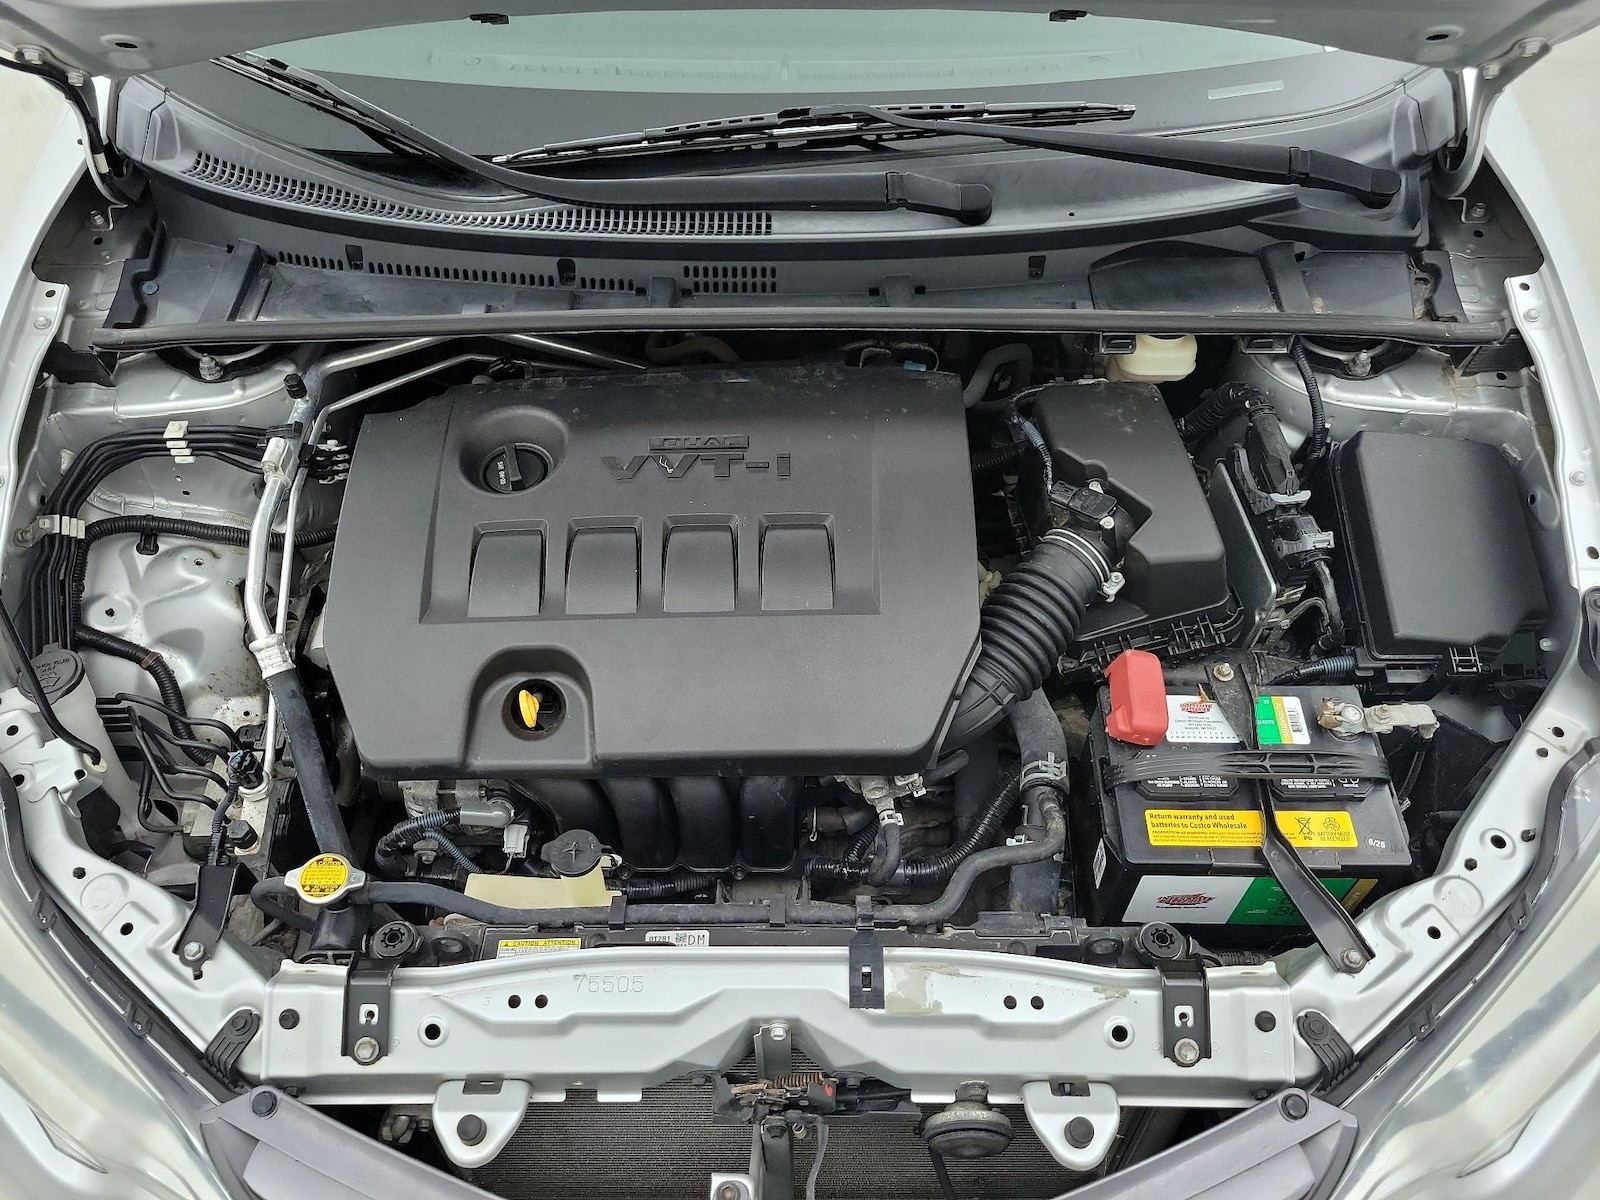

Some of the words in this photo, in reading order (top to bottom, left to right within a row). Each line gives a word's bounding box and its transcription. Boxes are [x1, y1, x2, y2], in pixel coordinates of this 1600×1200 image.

[1149, 812, 1172, 820] Return
[1173, 813, 1203, 821] warranty
[1219, 813, 1235, 821] used
[1181, 821, 1189, 829] to
[1212, 821, 1248, 829] Wholesale
[687, 933, 706, 946] DM
[574, 975, 645, 993] 75505
